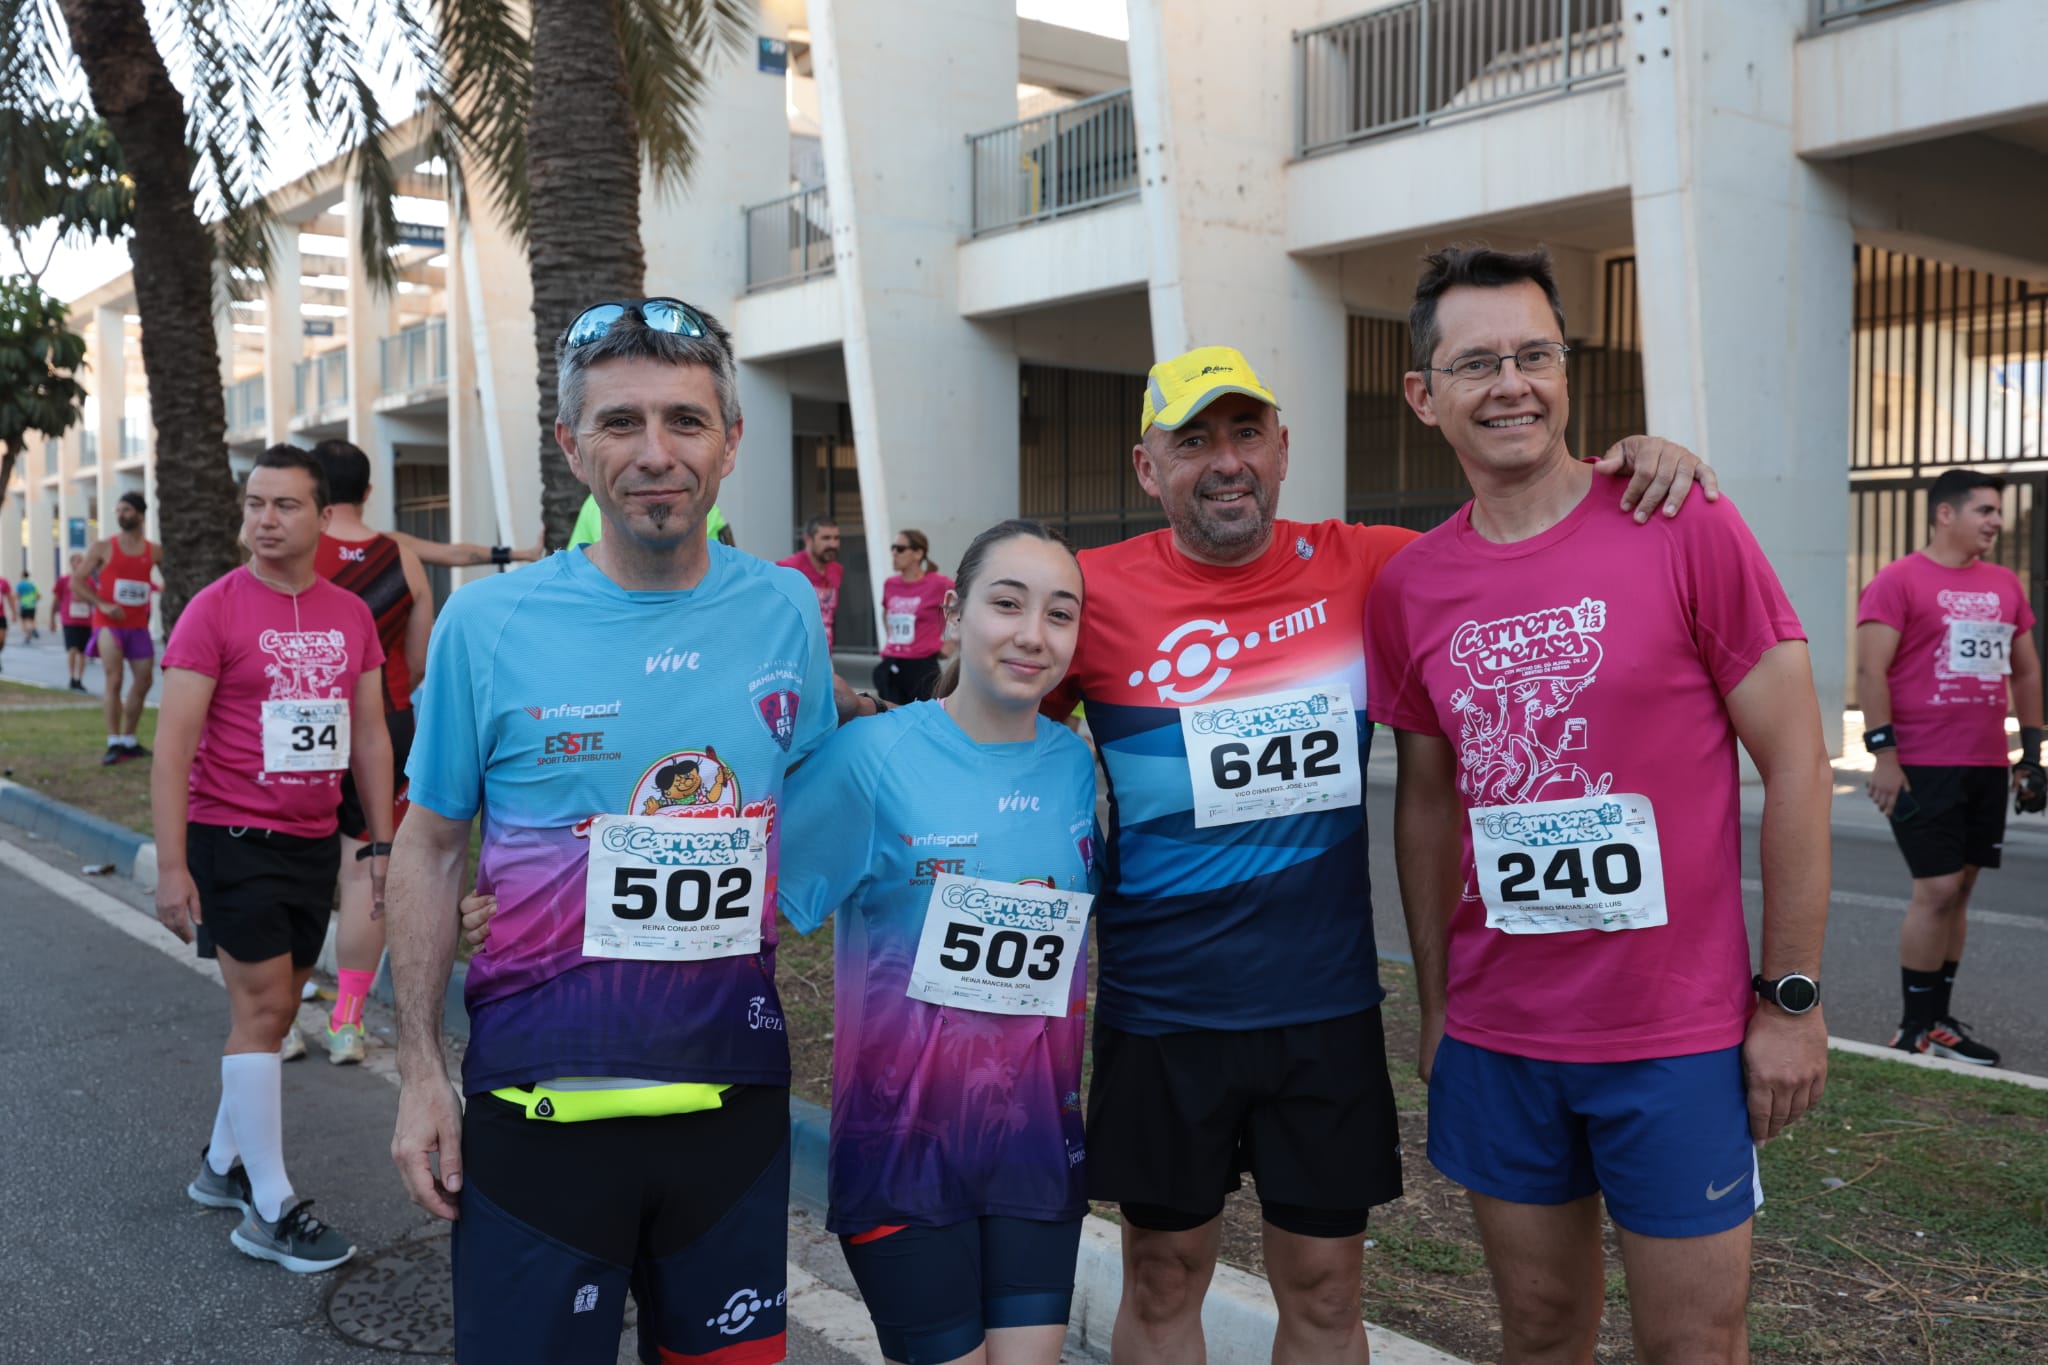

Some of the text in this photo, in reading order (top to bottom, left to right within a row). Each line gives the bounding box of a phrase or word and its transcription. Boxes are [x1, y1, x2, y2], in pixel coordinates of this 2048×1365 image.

[1578, 602, 1601, 614] de
[1456, 609, 1575, 653] Carrera
[1475, 630, 1584, 672] Prensa
[1960, 639, 2004, 660] 331
[541, 699, 622, 719] infisport
[1216, 702, 1310, 728] Carrera
[1236, 715, 1318, 737] Prensa
[292, 724, 337, 751] 34
[537, 751, 622, 766] SPORT DISTRIBUTION
[1210, 730, 1341, 789] 642
[1504, 811, 1600, 835] Carrera
[628, 827, 733, 851] Carrera
[911, 832, 979, 847] infisport
[1523, 825, 1611, 846] Prensa
[650, 849, 736, 865] Prensa
[1497, 843, 1642, 902] 240
[612, 867, 752, 921] 502
[965, 888, 1051, 916] Carrera
[1605, 900, 1622, 908] LUIS
[642, 924, 666, 932] REINA
[981, 909, 1052, 930] Prensa
[940, 922, 1064, 981] 503
[961, 976, 981, 984] REINA
